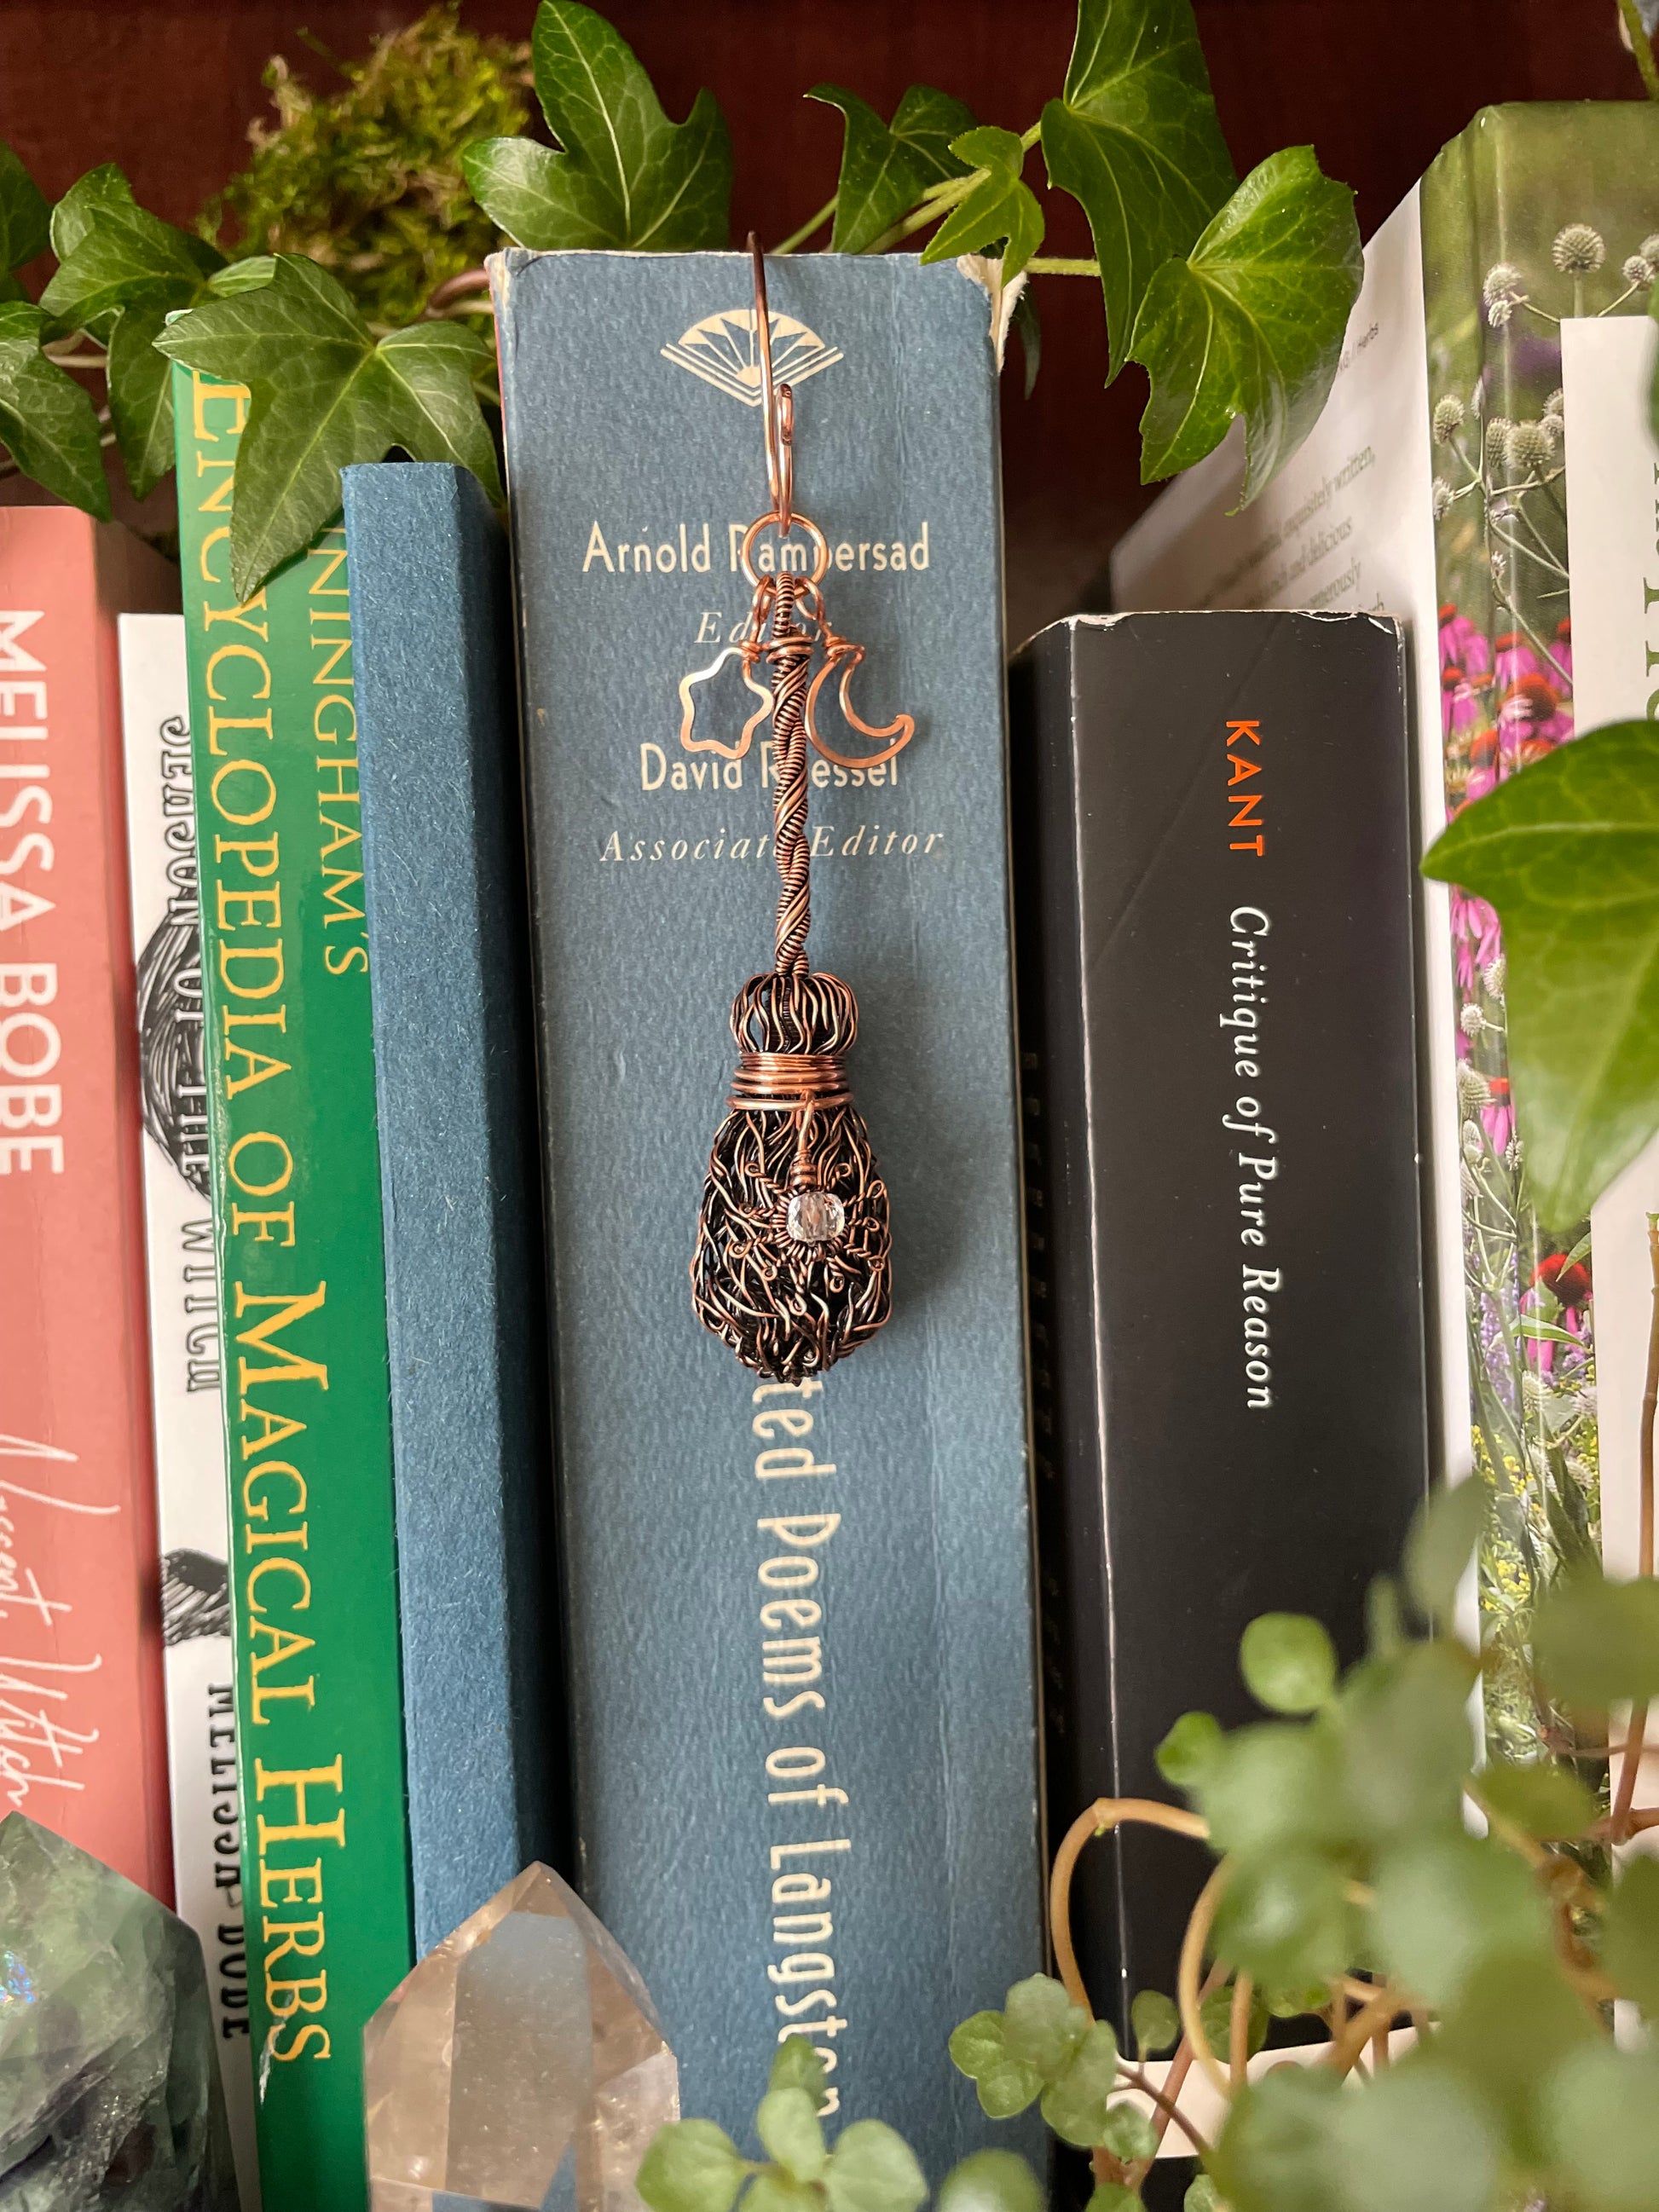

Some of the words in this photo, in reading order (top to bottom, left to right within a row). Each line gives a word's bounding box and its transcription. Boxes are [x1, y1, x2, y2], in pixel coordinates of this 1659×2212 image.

[581, 522, 711, 574] Arnold
[0, 609, 56, 932] MELISSA
[640, 742, 743, 792] David
[760, 738, 898, 788] Ressel
[1226, 719, 1264, 857] KANT
[599, 827, 778, 862] Associat
[809, 823, 945, 859] Editor
[1220, 905, 1270, 1078] Critique
[0, 962, 64, 1175] BOBE
[1223, 1096, 1277, 1143] of
[228, 1130, 295, 1247] OF
[1239, 1152, 1280, 1248] Pure
[1241, 1265, 1284, 1409] Reason
[234, 1281, 329, 1724] MAGICAL
[756, 1513, 841, 1720] Poems
[765, 1745, 849, 1806] of
[255, 1754, 346, 2061] HERBS
